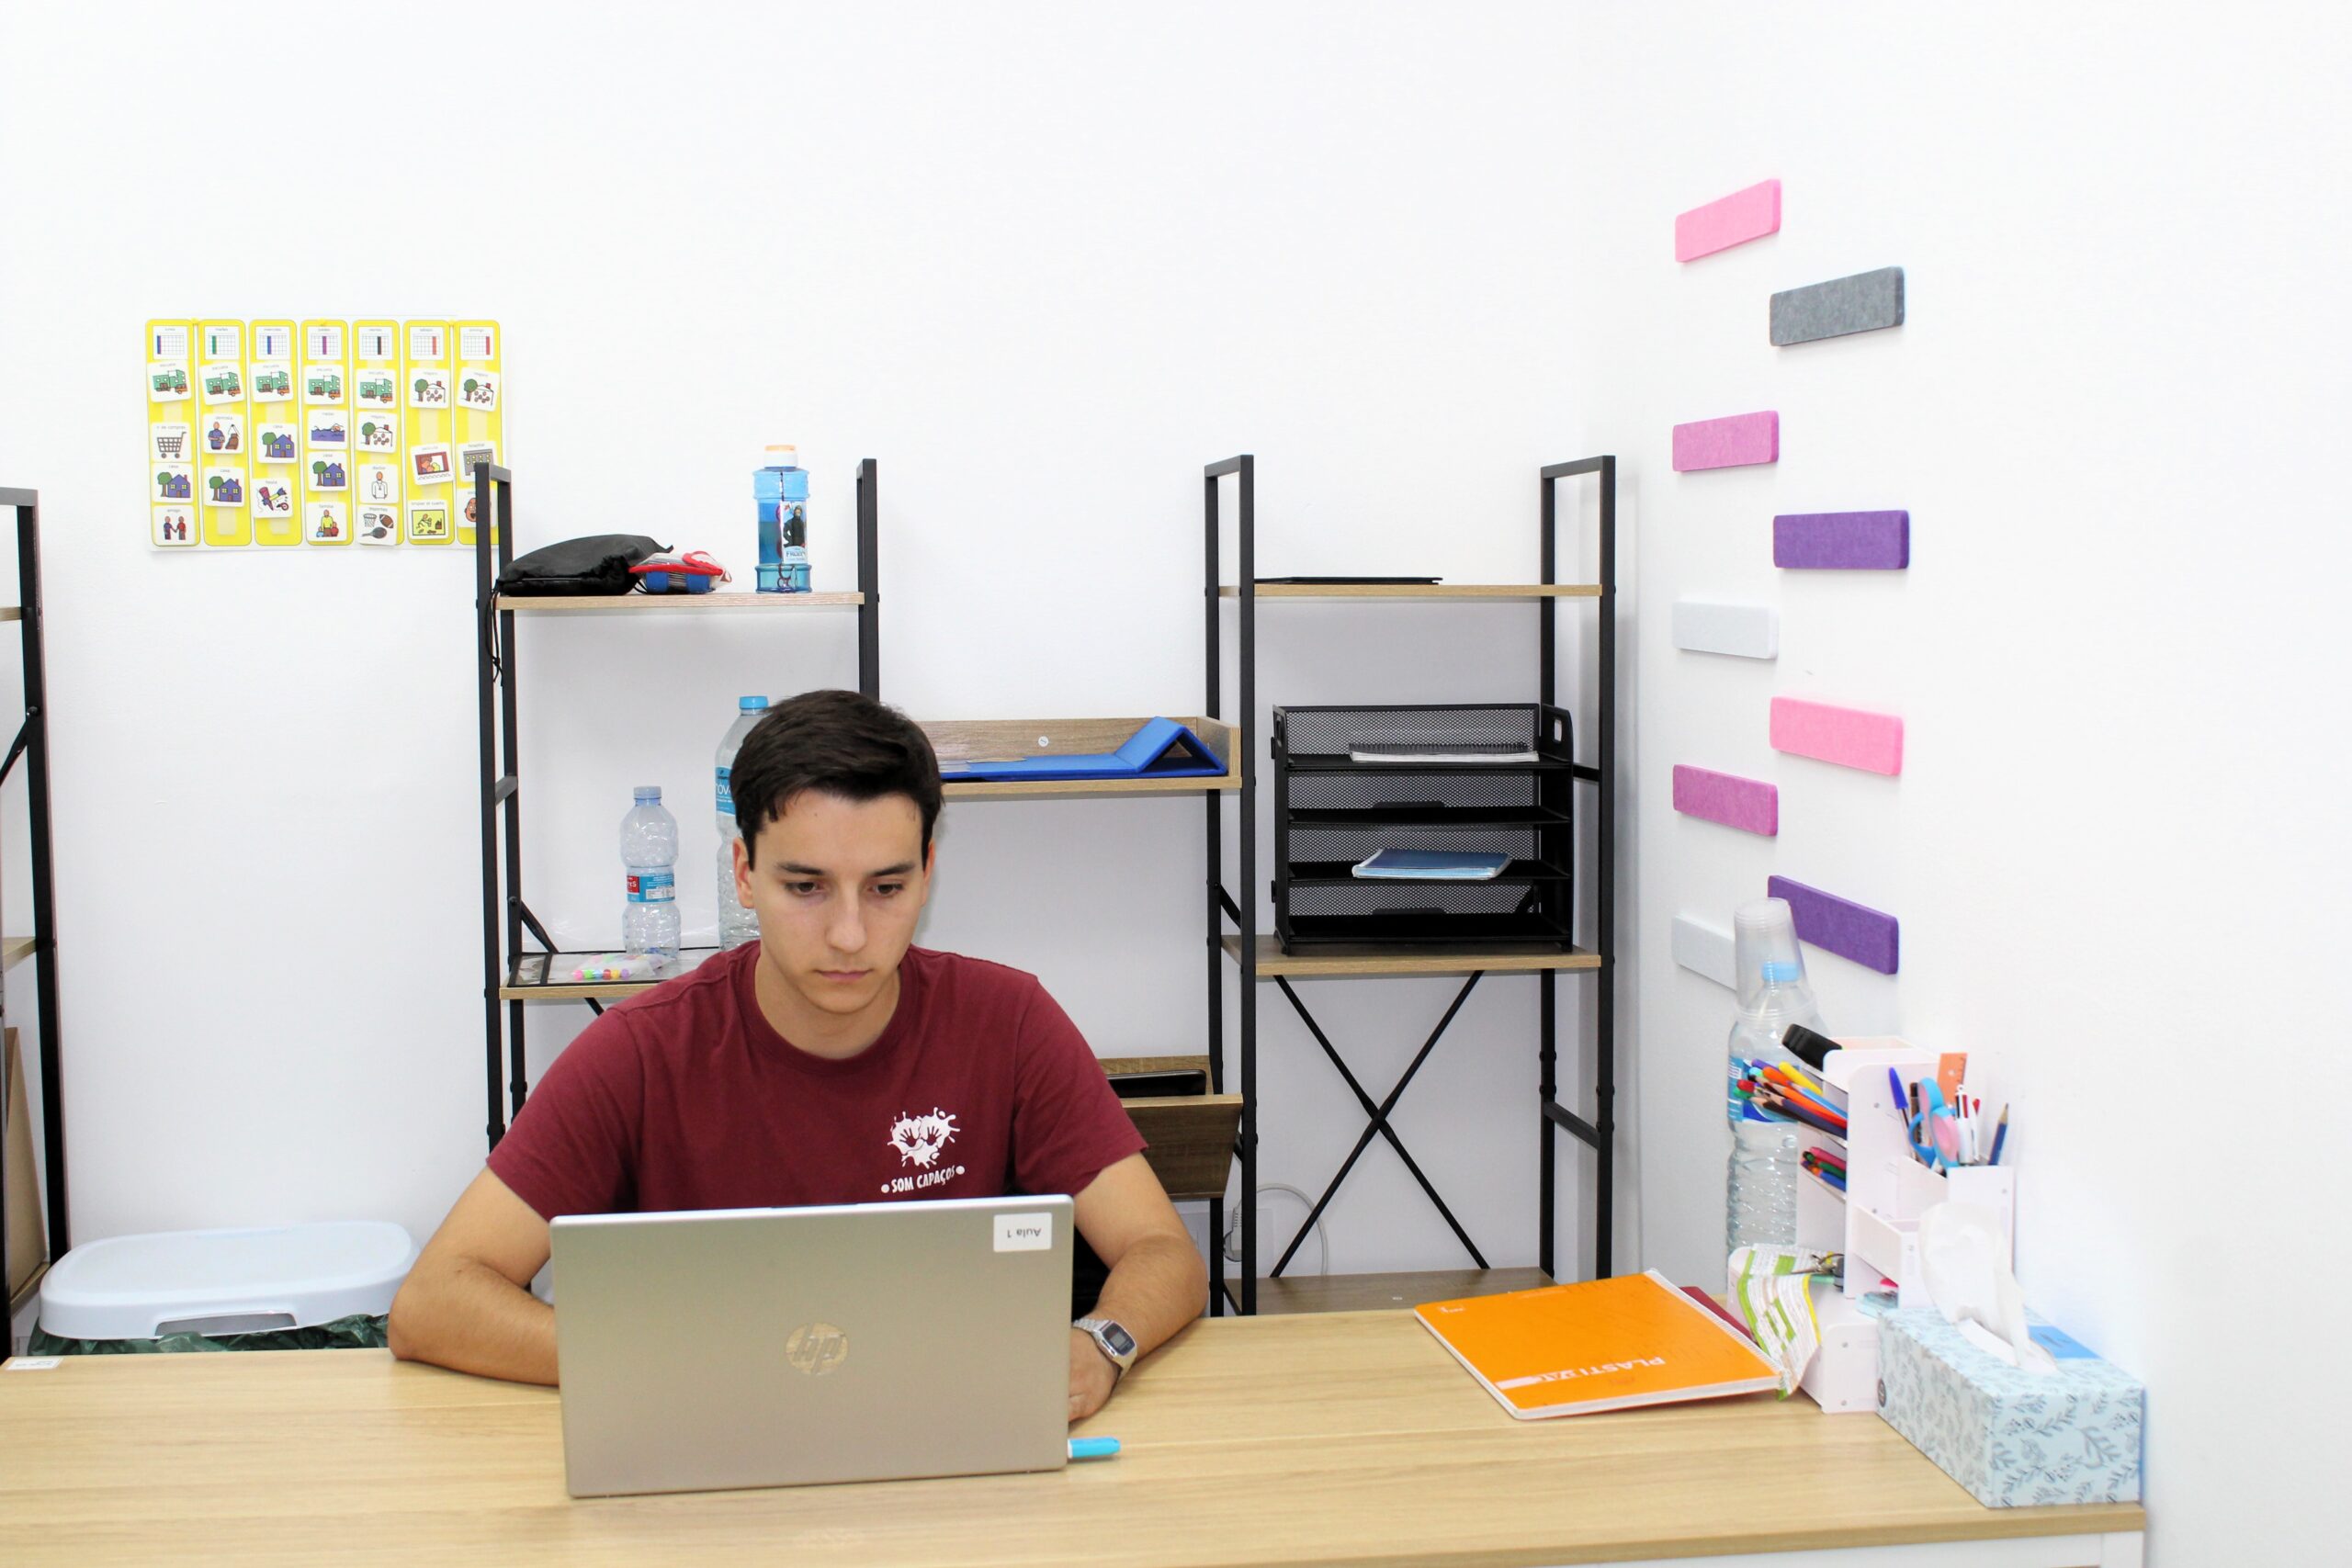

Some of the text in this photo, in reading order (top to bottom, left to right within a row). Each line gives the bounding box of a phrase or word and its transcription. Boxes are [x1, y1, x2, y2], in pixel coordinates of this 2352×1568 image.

[891, 1165, 956, 1193] SOM CAPAÇOS
[1016, 1227, 1042, 1237] Aula
[792, 1323, 841, 1375] hp
